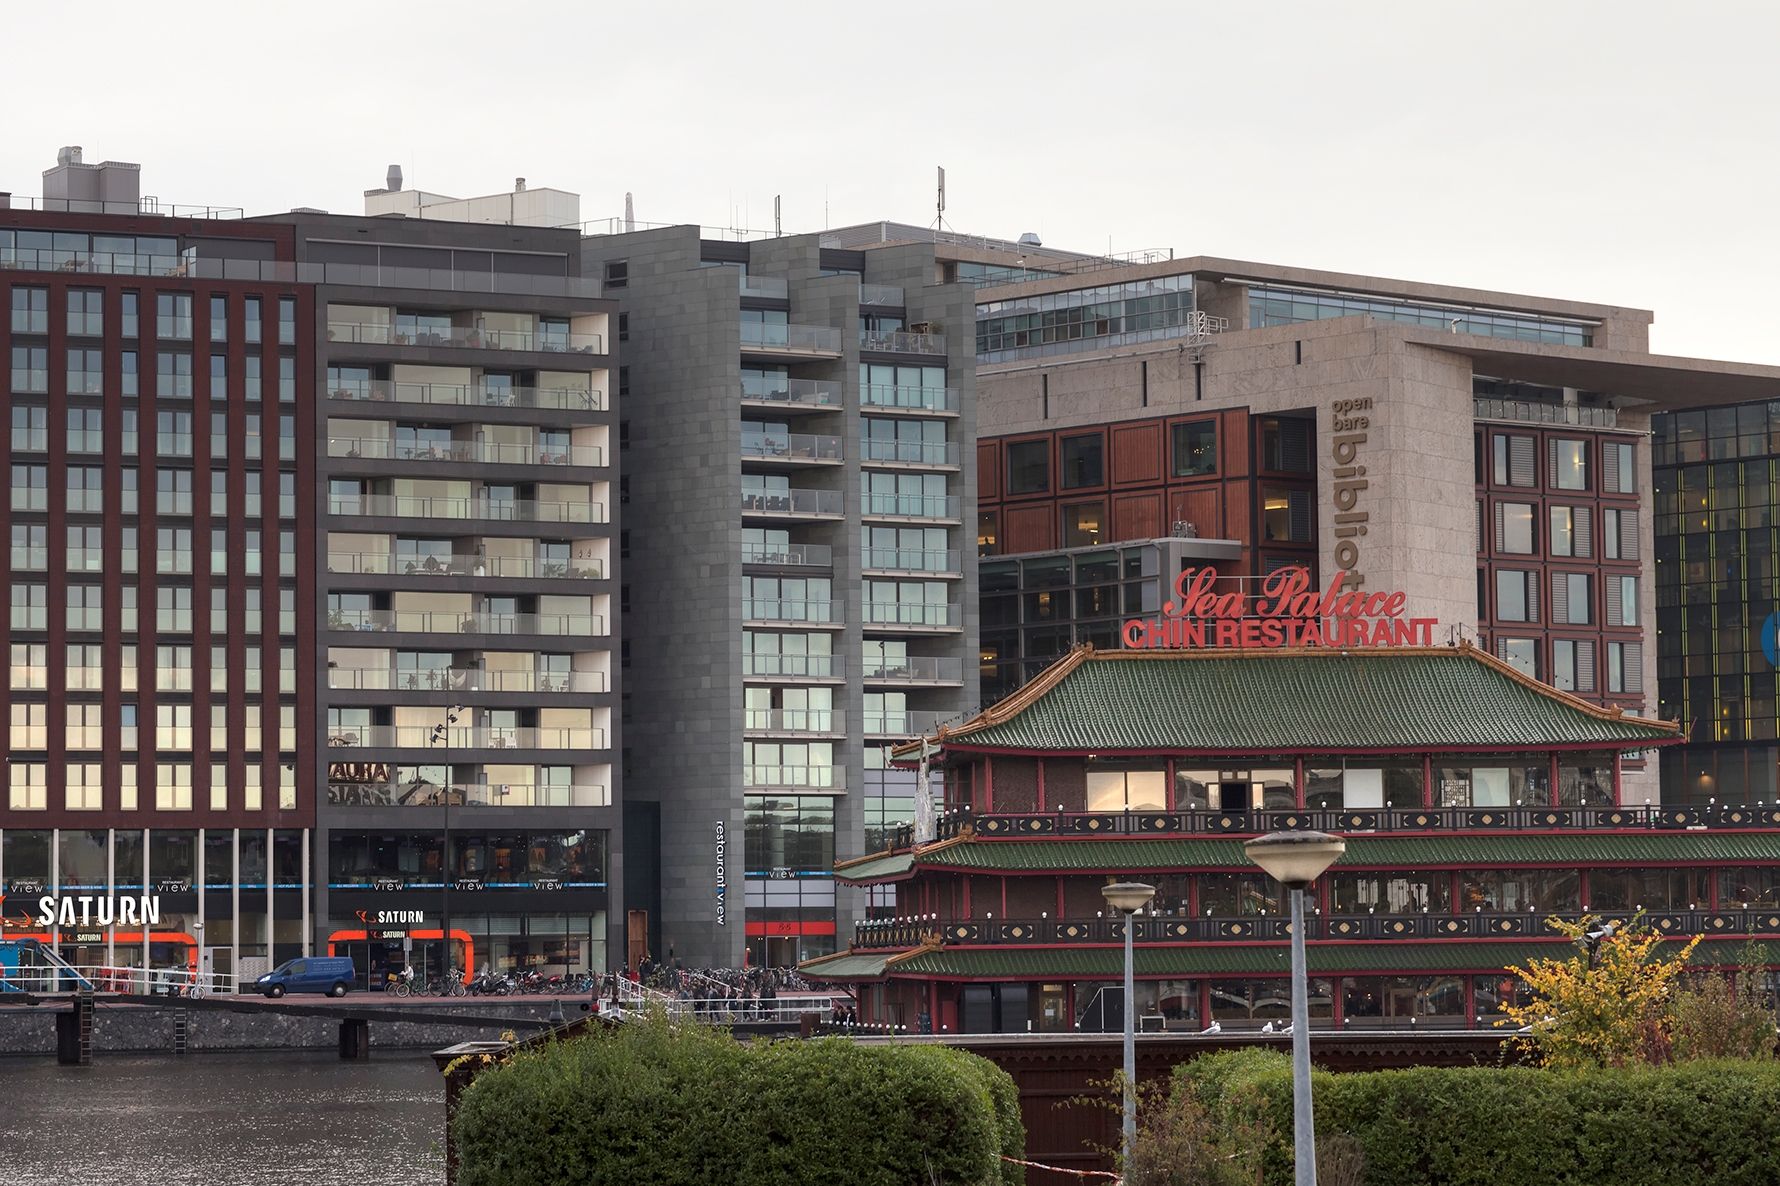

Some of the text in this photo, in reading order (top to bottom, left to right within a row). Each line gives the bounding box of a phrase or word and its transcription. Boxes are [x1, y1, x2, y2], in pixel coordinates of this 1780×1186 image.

[1332, 397, 1372, 416] open
[1333, 414, 1369, 432] bare
[1333, 433, 1369, 596] bibliot
[1163, 566, 1406, 618] Sea Palace
[1122, 618, 1438, 649] CHIN RESTAURANT
[716, 821, 726, 925] restaurant view
[39, 895, 160, 926] SATURN
[378, 910, 424, 923] SATURN
[77, 933, 102, 942] SATURN
[382, 931, 406, 939] SATURN
